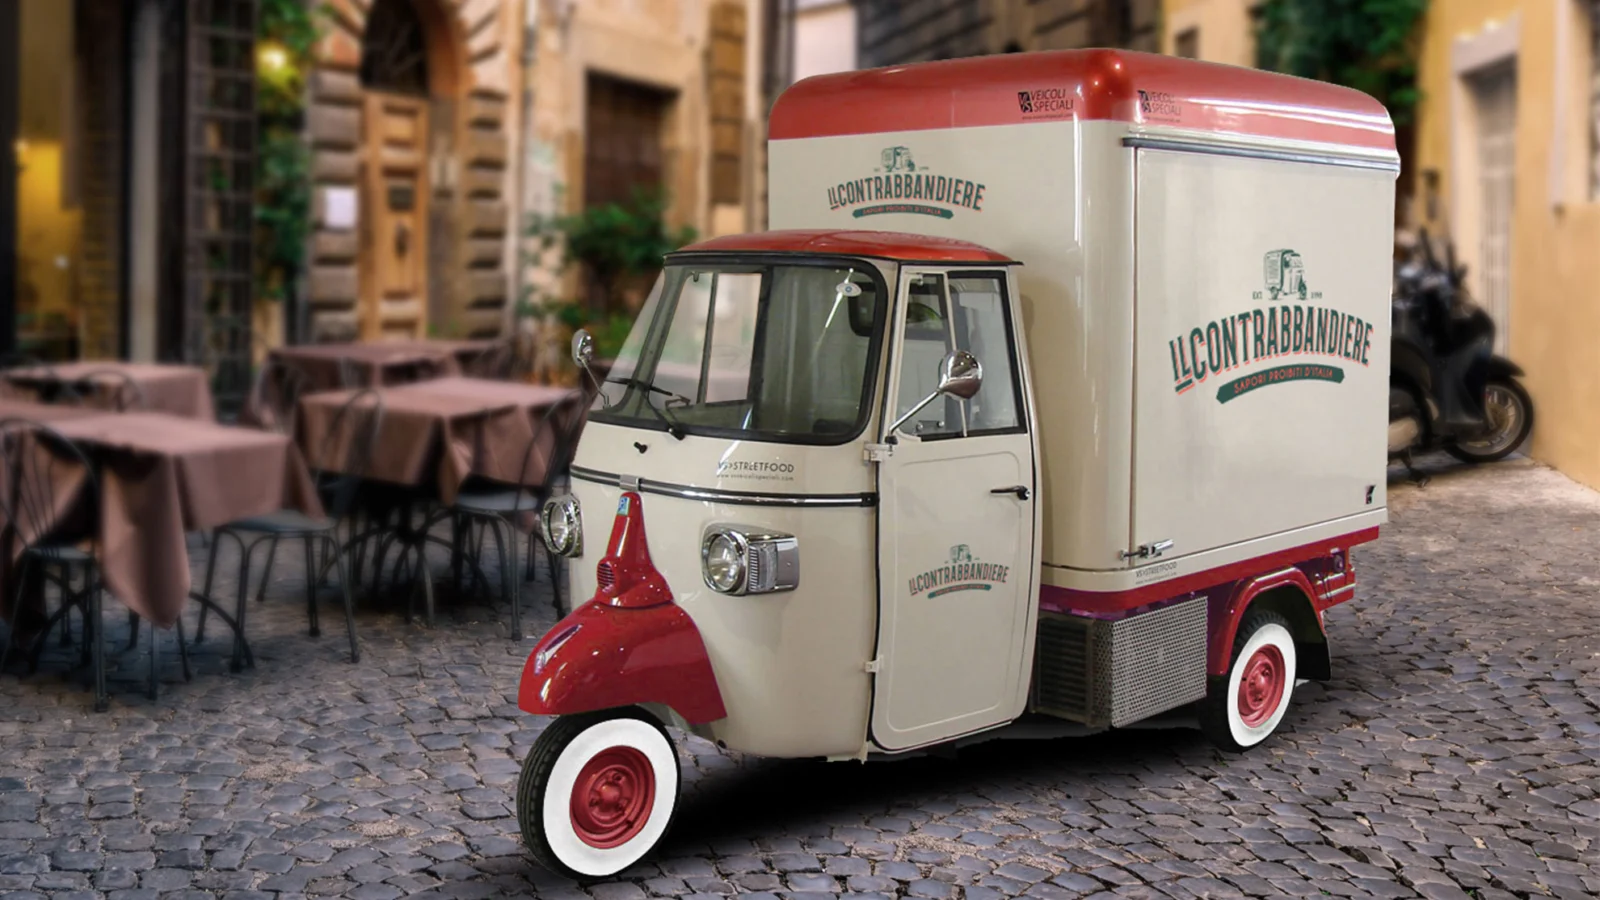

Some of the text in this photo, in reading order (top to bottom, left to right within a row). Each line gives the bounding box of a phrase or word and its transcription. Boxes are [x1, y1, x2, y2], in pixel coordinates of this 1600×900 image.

[1031, 88, 1067, 100] VEICOLI
[1033, 99, 1074, 112] SPECIALI
[1150, 102, 1181, 115] SPECIALI
[838, 174, 986, 212] CONTRABBANDIERE
[1189, 305, 1374, 384] CONTRABBANDIERE
[1233, 366, 1333, 394] SAPORI PROIBITI D'ITALIA
[916, 562, 1009, 592] CONTRABBANDIERE
